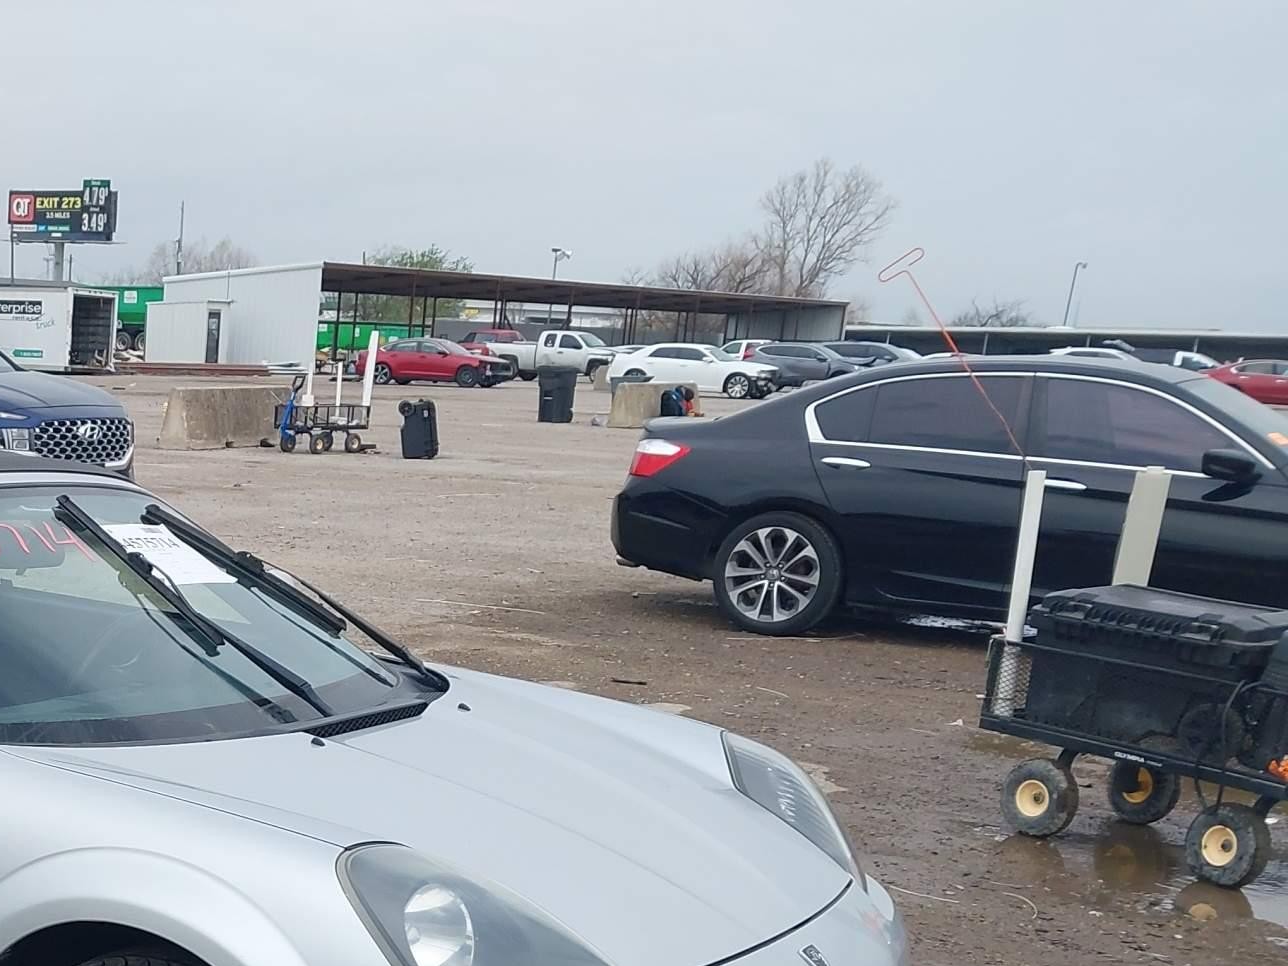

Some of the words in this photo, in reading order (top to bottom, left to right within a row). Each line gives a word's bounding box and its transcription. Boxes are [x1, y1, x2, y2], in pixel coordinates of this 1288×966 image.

[13, 198, 30, 217] QT
[35, 197, 59, 208] EXIT
[61, 197, 81, 208] 273
